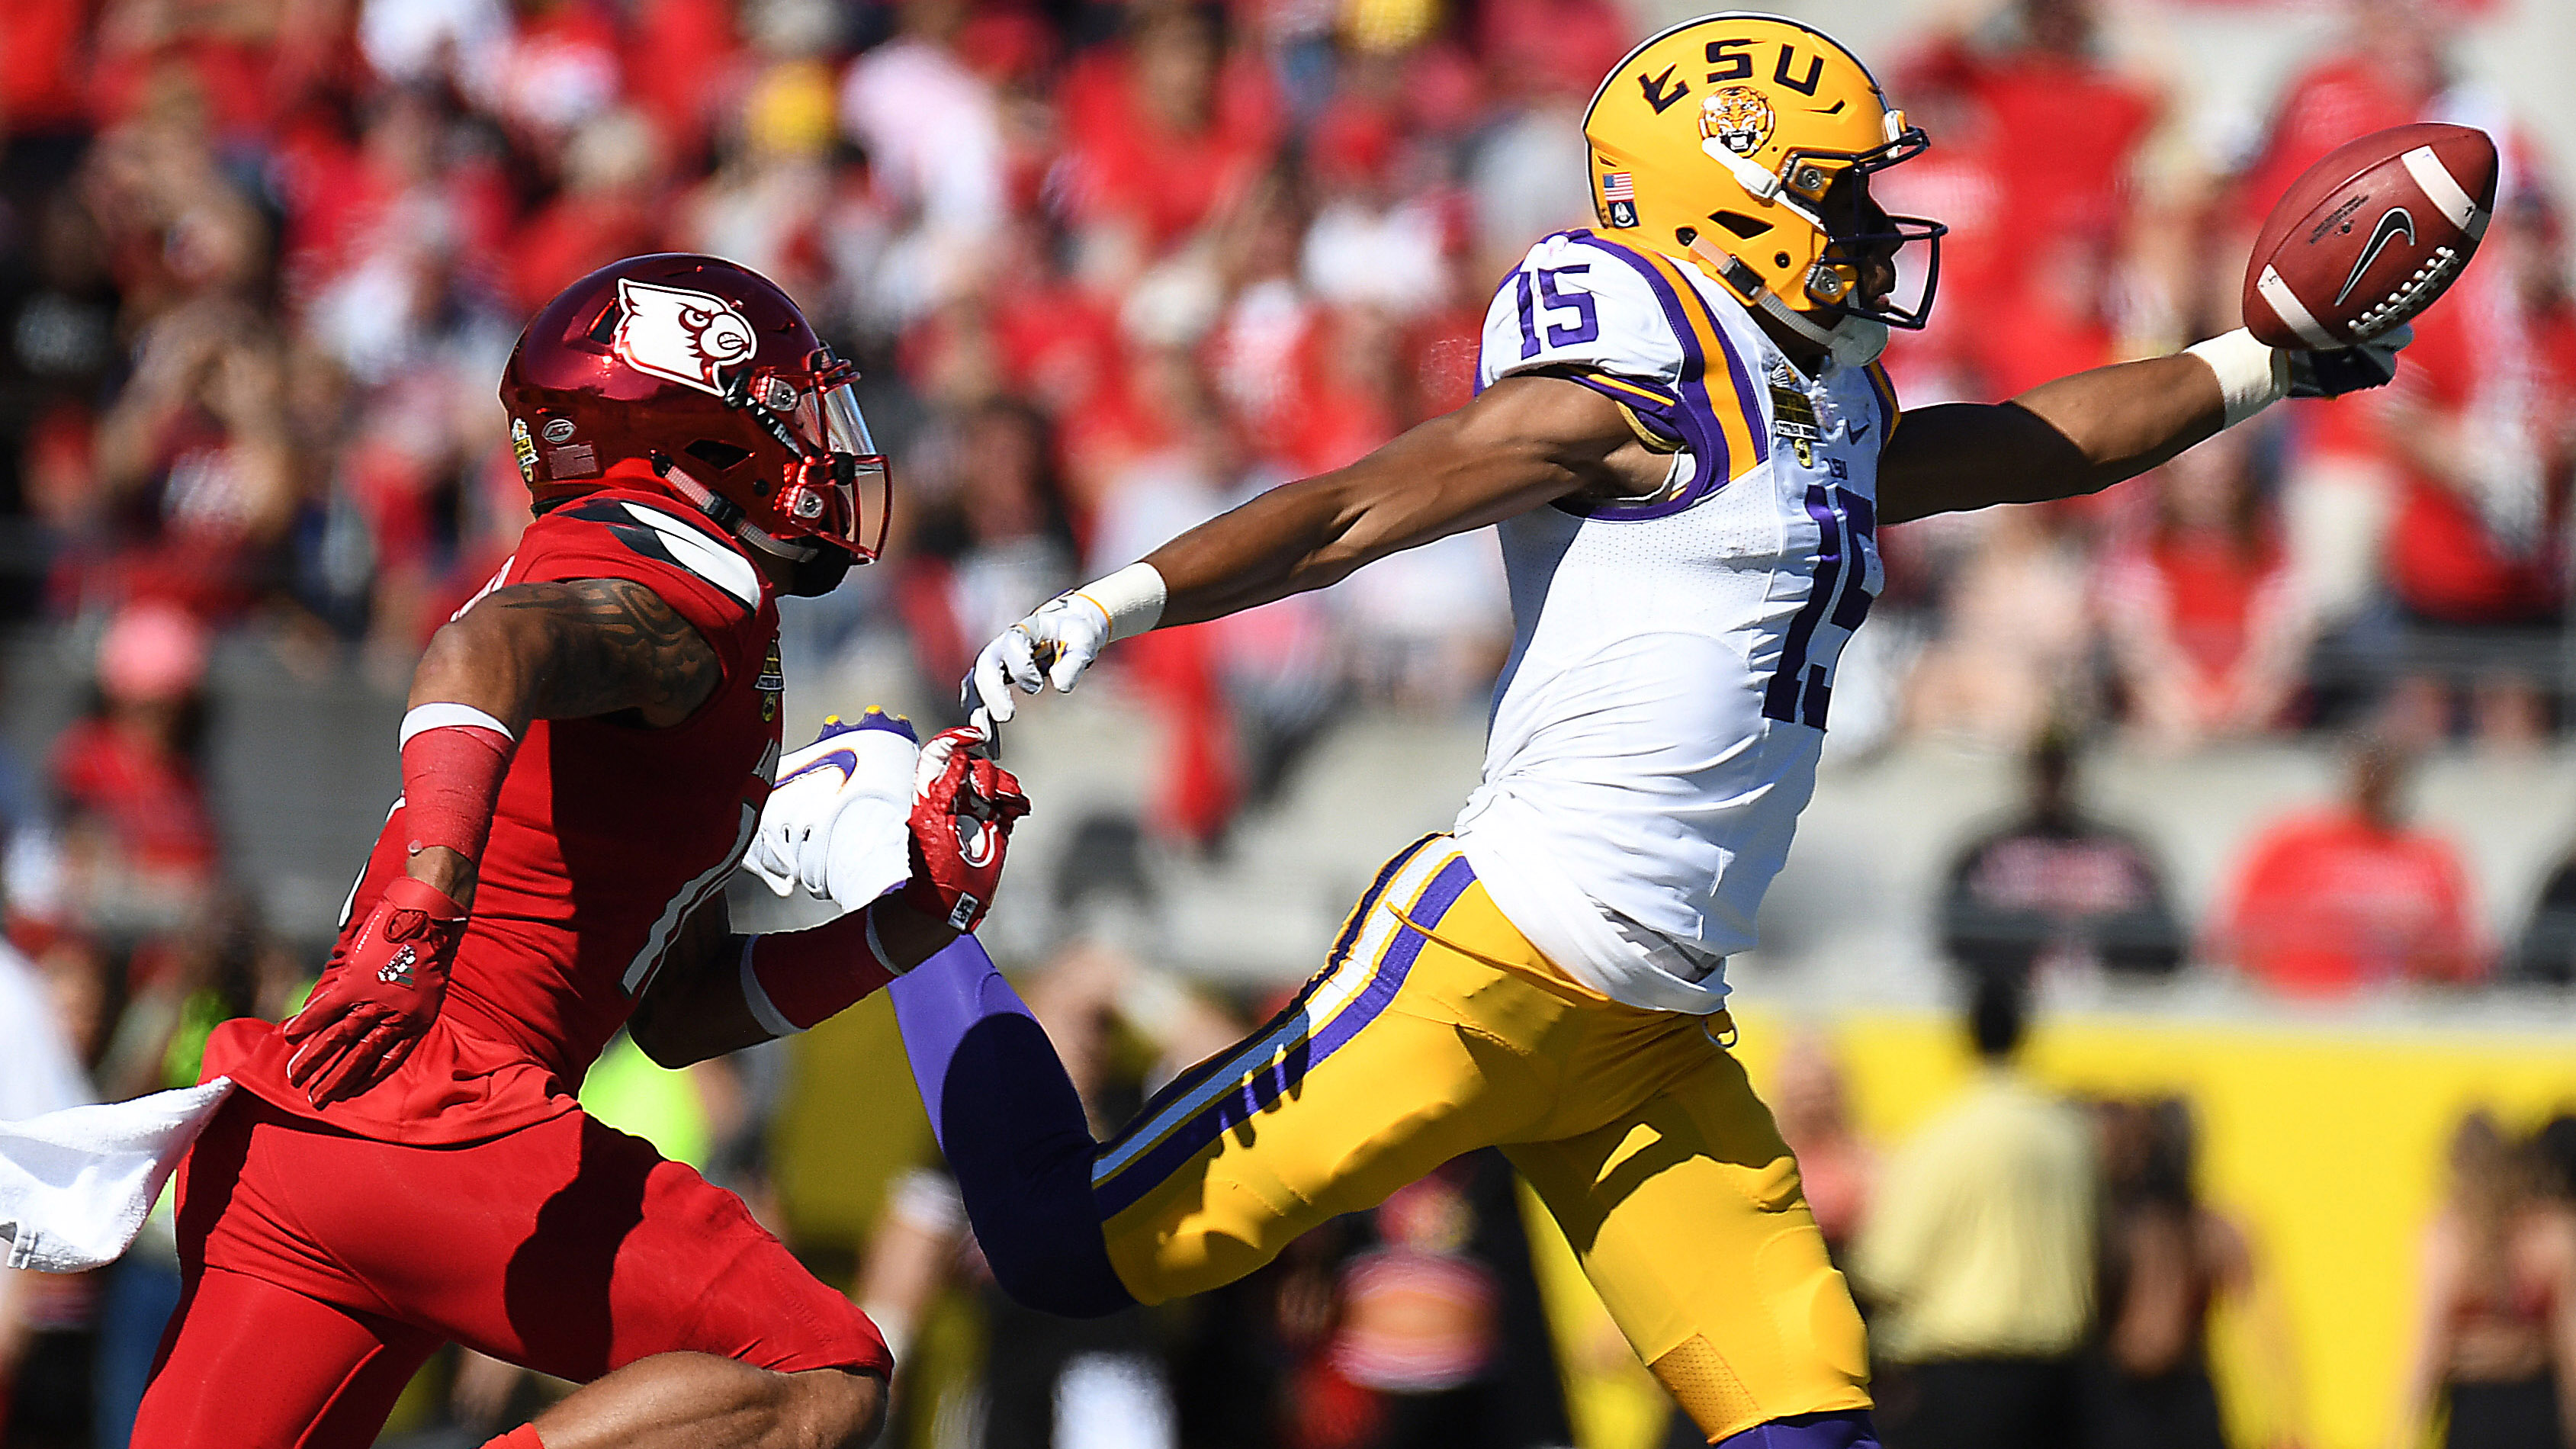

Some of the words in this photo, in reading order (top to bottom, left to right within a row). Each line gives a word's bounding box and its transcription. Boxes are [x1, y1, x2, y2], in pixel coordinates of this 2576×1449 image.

[1638, 38, 1825, 115] LSU
[1516, 264, 1600, 360] 15
[1761, 484, 1874, 731] 15
